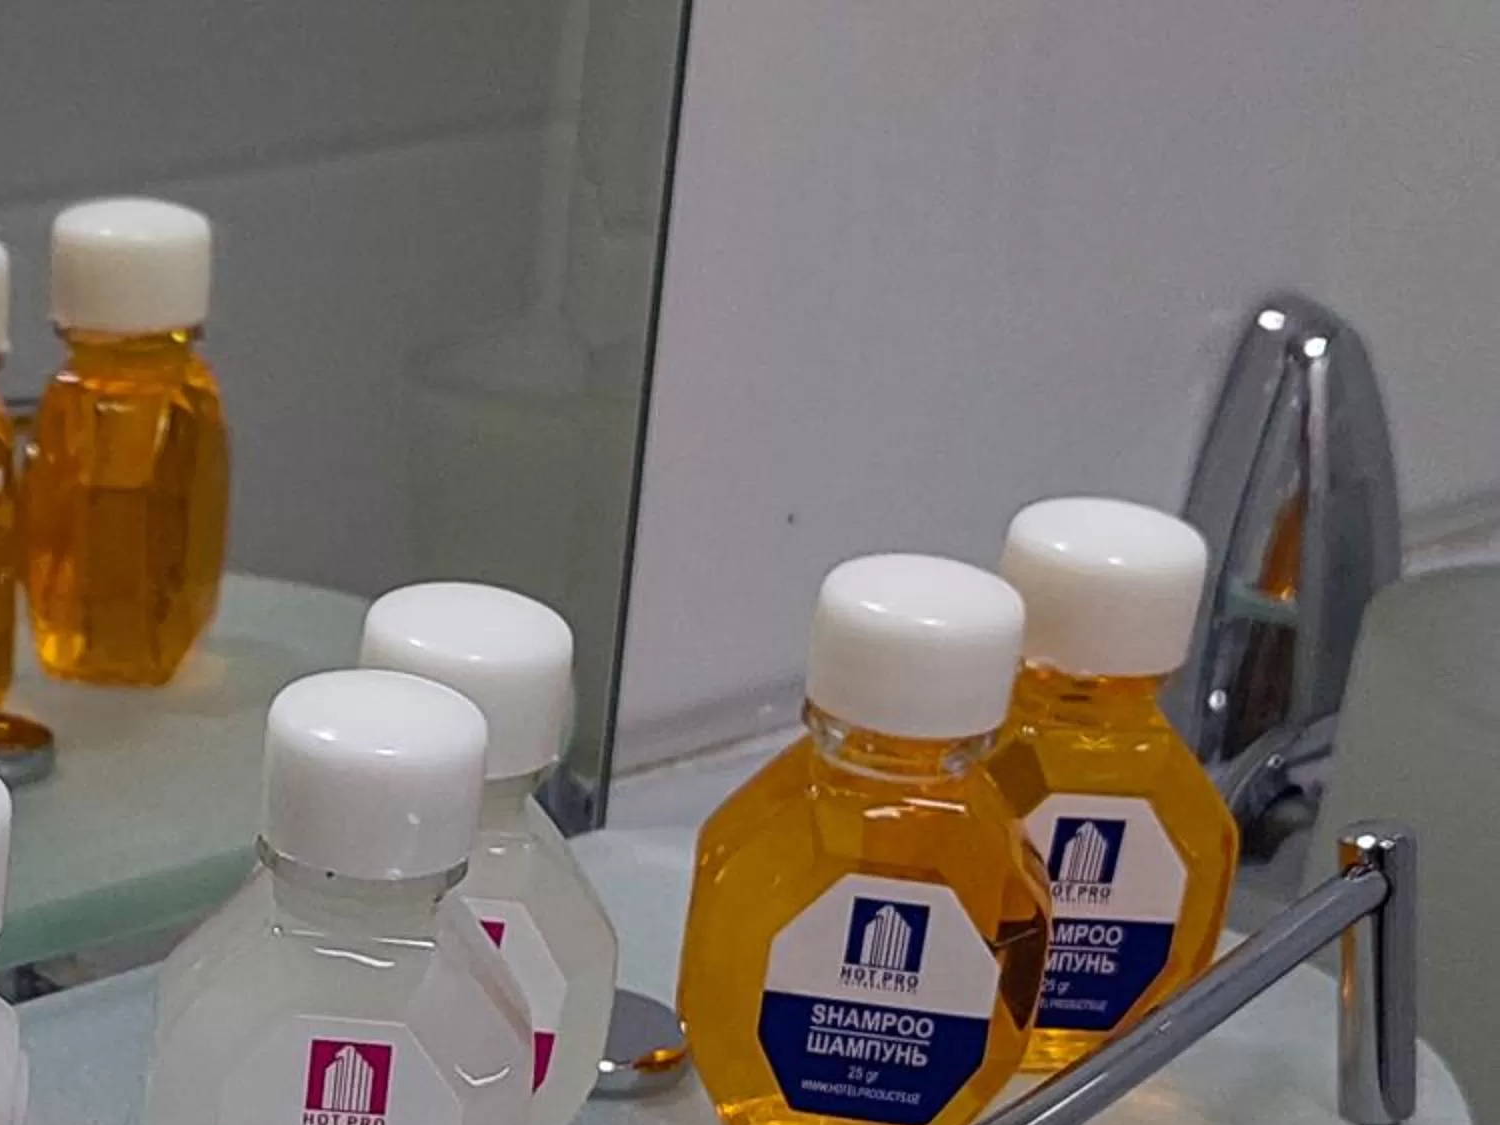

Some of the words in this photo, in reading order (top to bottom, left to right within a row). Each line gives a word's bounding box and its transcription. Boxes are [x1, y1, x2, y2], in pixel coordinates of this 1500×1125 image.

[1077, 885, 1111, 899] PRO
[1052, 922, 1124, 946] MPOO
[840, 965, 877, 985] HOT
[882, 971, 919, 989] PRO
[810, 1003, 935, 1039] SHAMPOO
[805, 1031, 929, 1068] ШАМПУНЬ
